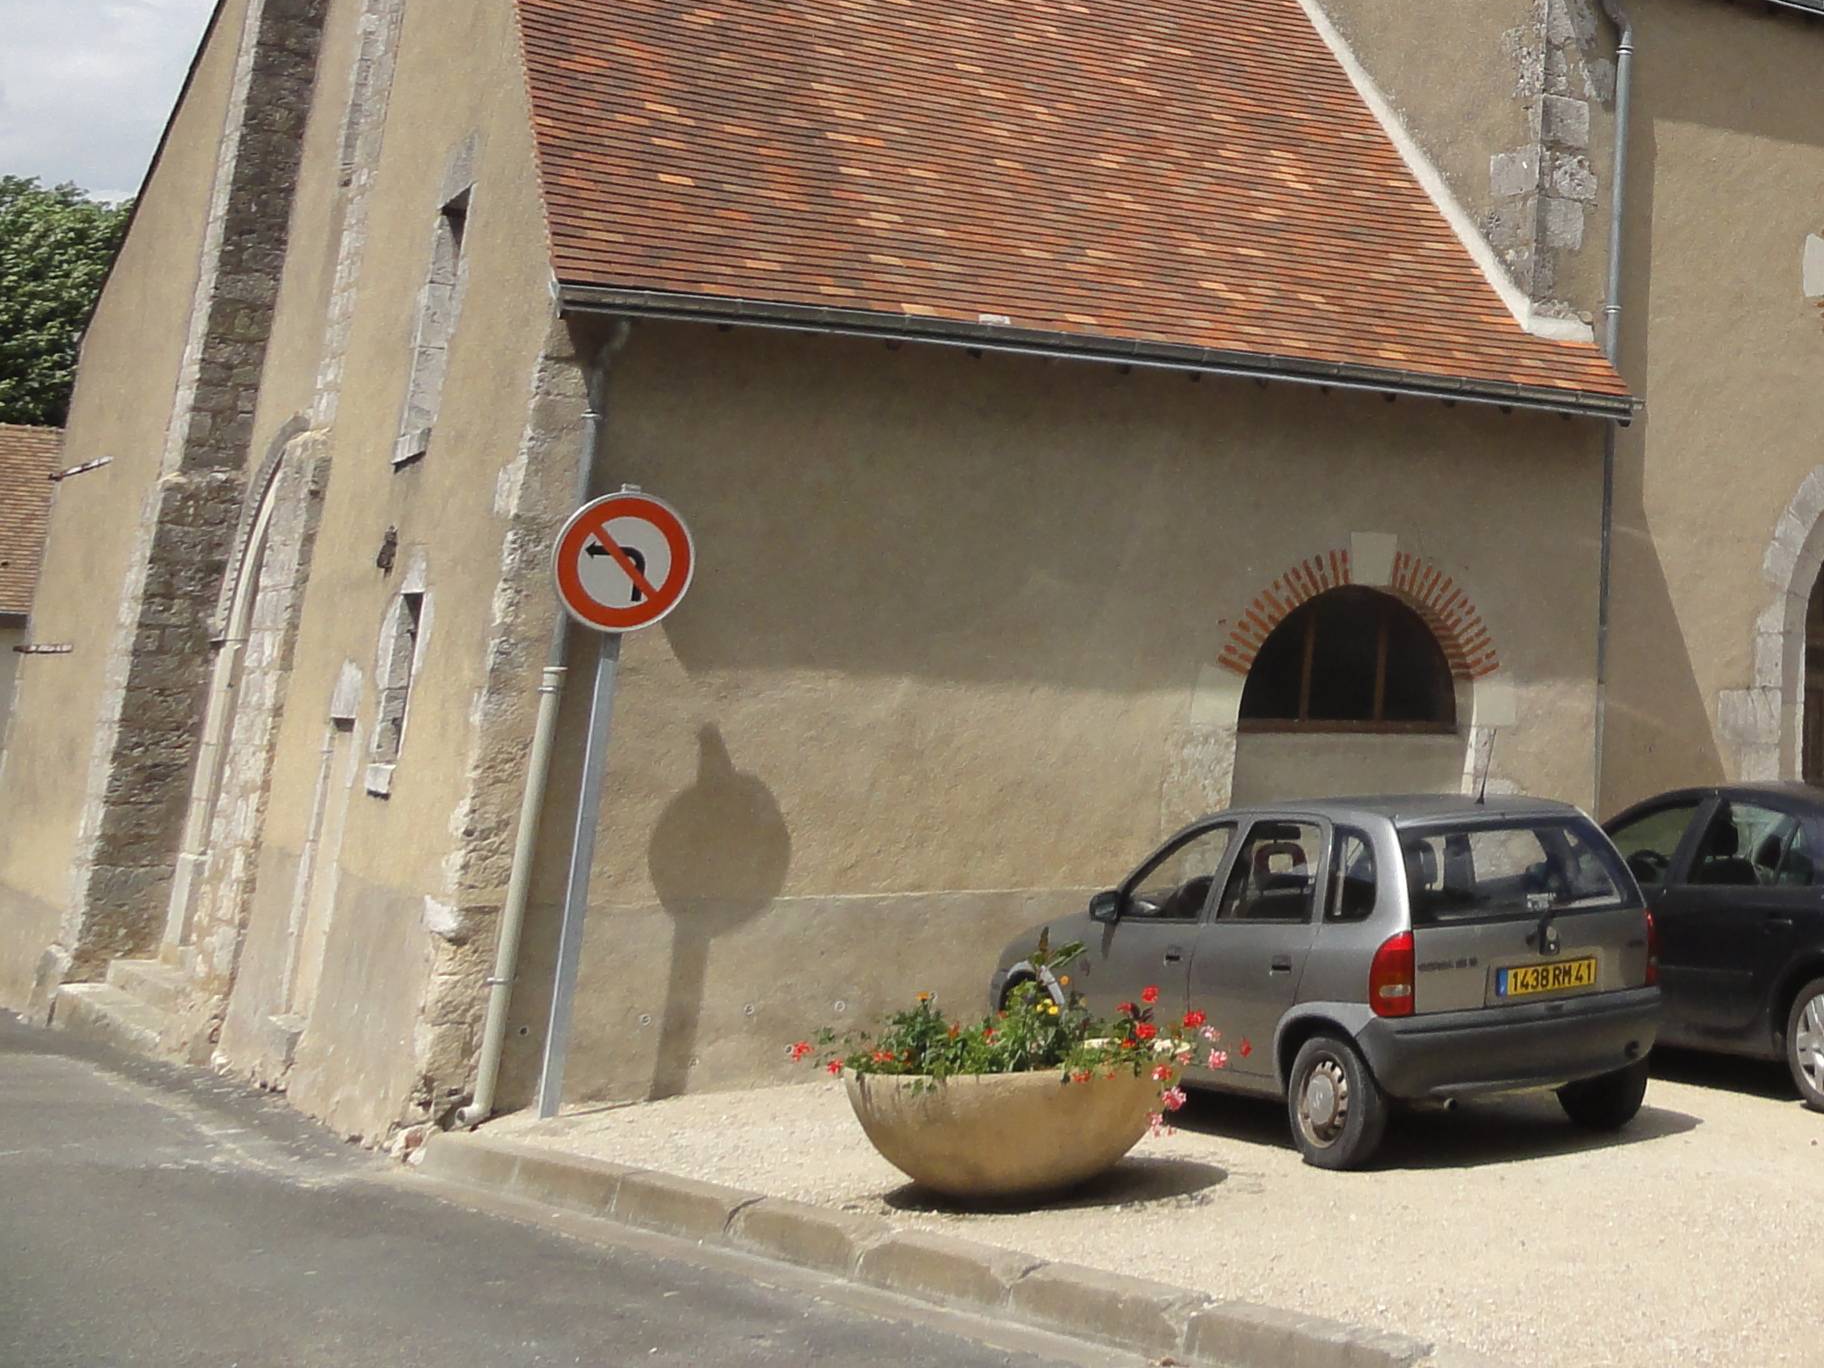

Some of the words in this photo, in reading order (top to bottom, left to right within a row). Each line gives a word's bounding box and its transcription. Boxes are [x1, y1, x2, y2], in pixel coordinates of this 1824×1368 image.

[1512, 967, 1550, 992] 1438
[1552, 963, 1572, 986] RM
[1574, 961, 1592, 982] 41
